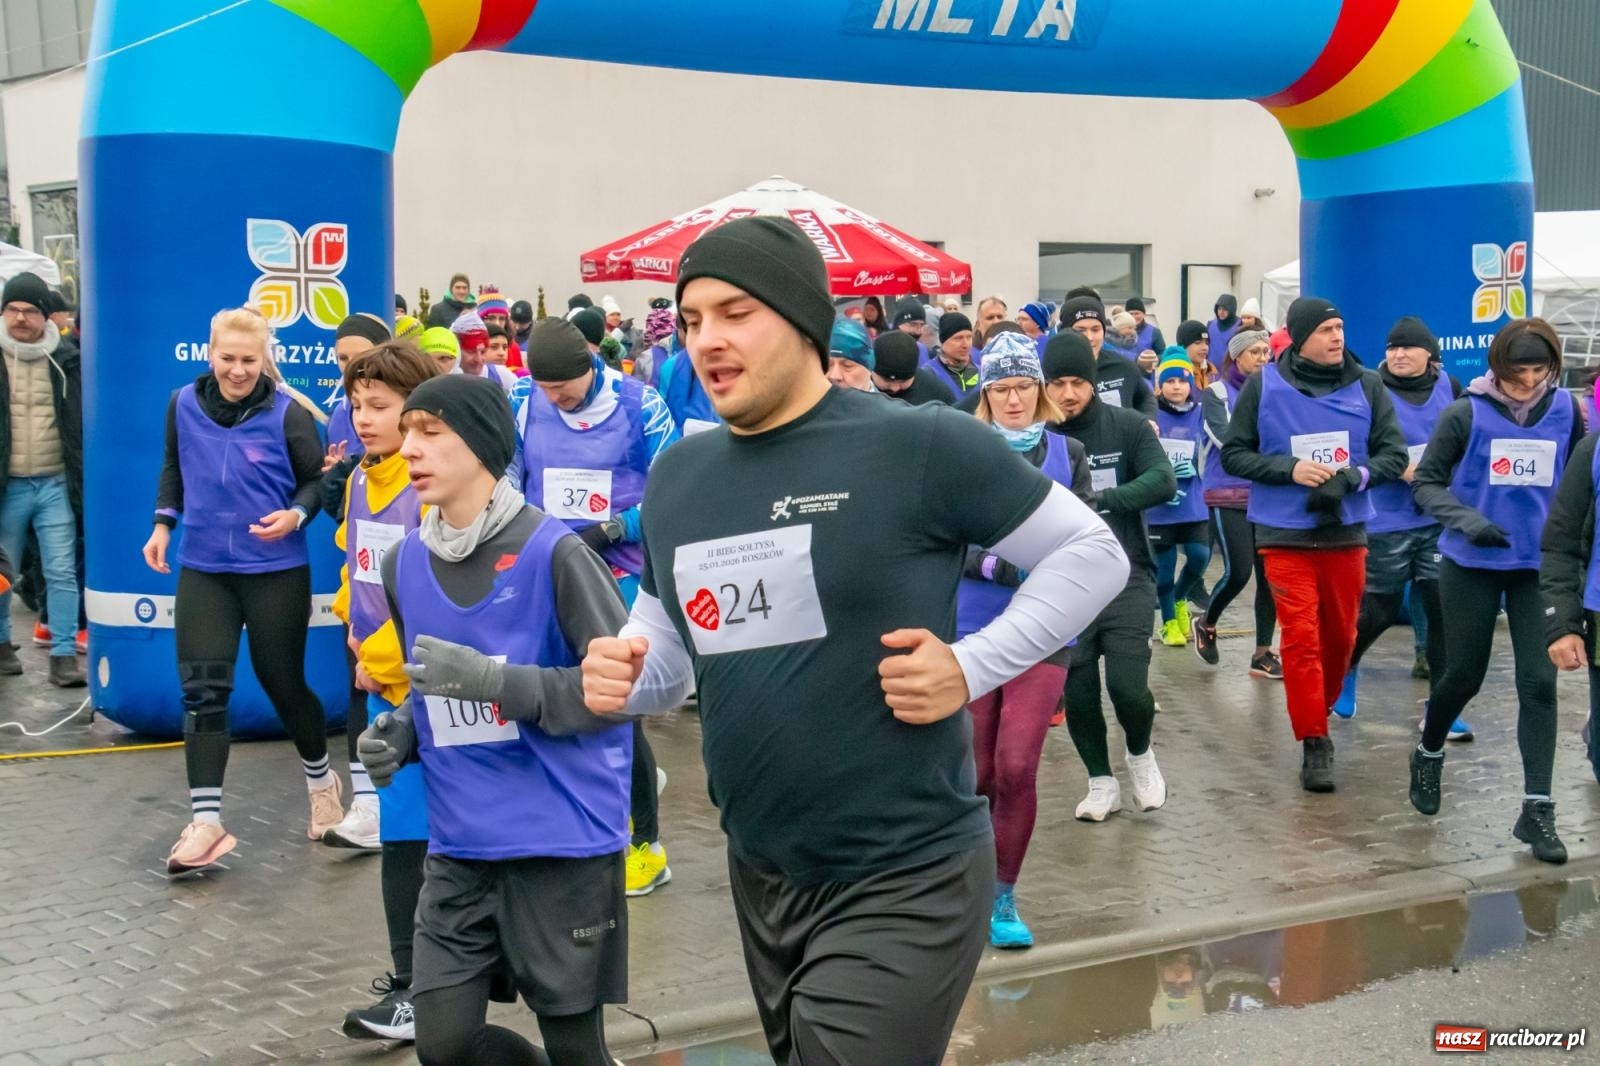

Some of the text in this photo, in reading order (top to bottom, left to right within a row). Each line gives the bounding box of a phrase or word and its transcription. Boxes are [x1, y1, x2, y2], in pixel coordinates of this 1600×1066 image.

[853, 270, 896, 287] Classic
[1312, 448, 1333, 464] 65
[1513, 458, 1536, 476] 64
[562, 488, 588, 507] 37
[707, 549, 714, 558] II
[716, 546, 736, 557] BIEG
[720, 578, 772, 626] 24
[443, 698, 495, 728] 106
